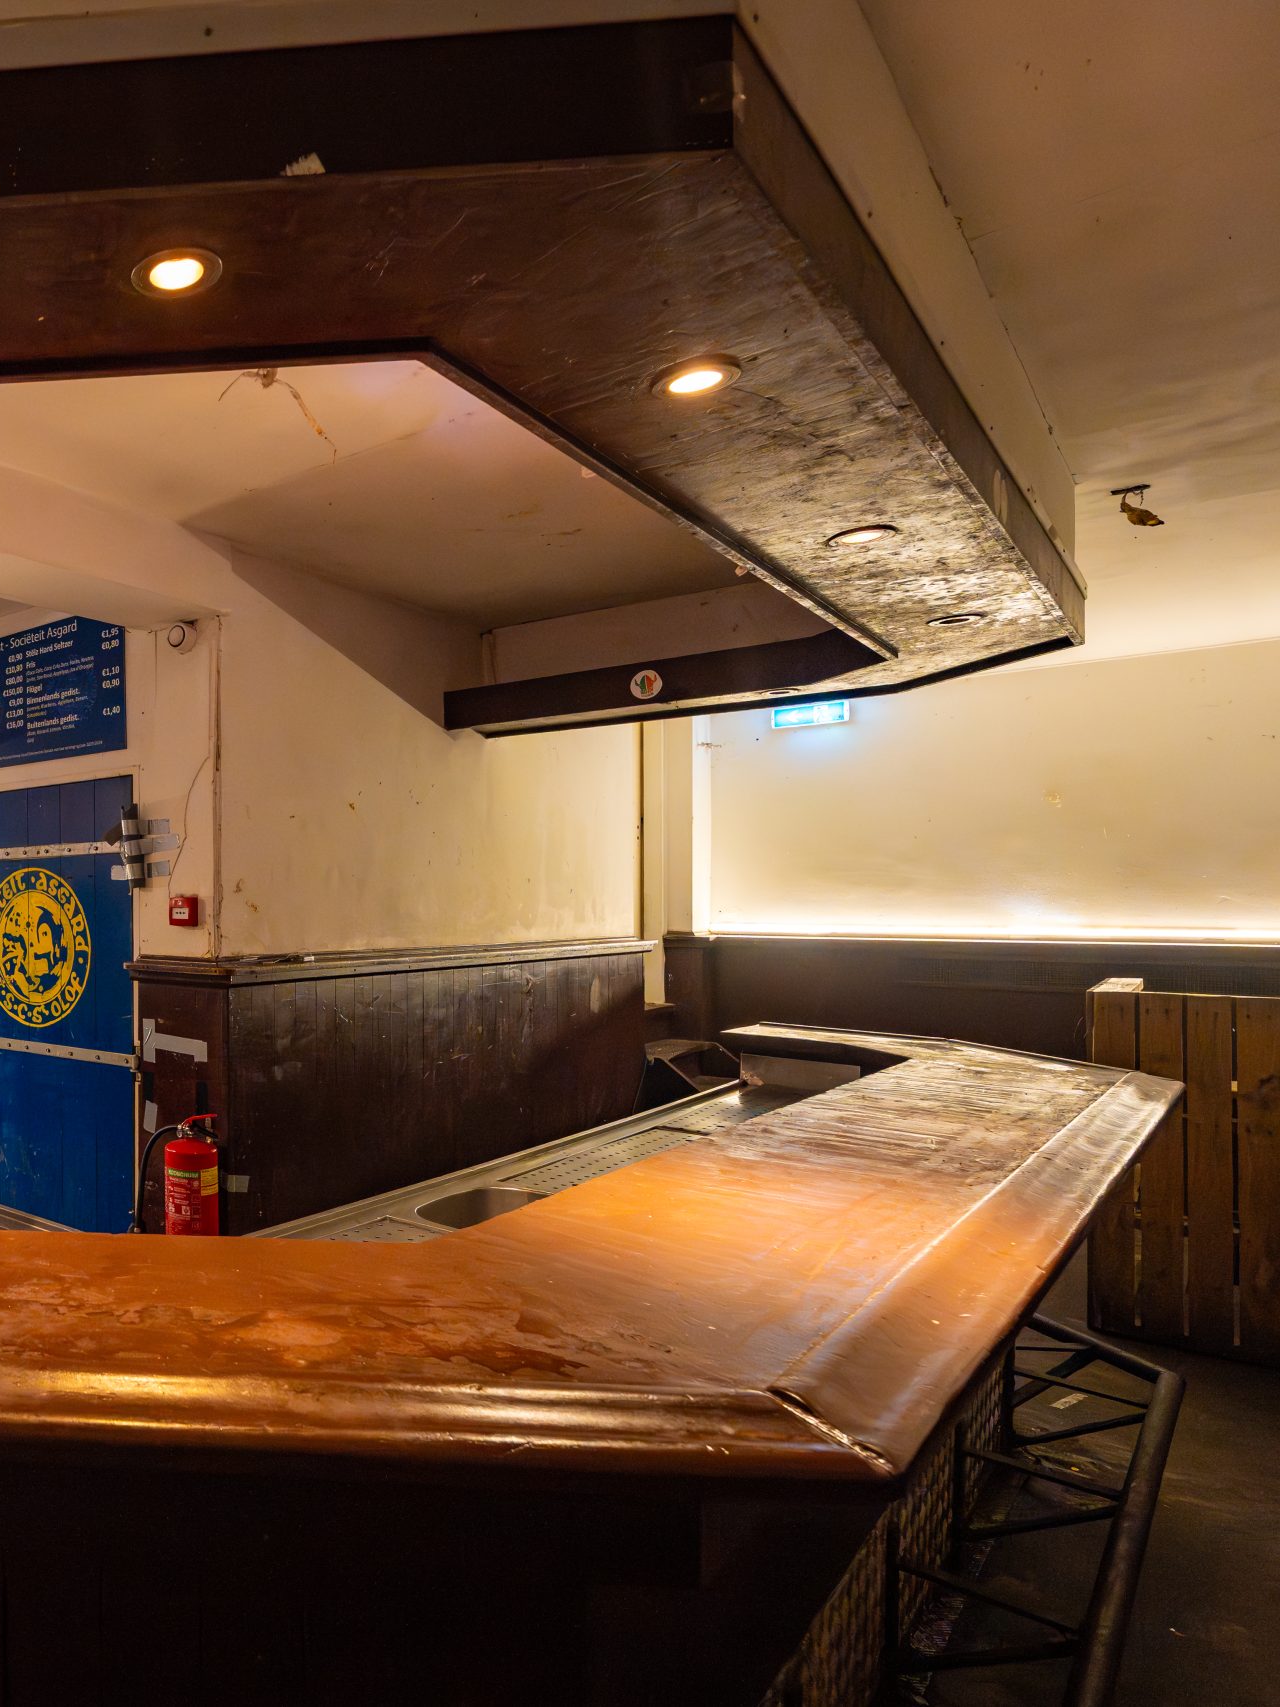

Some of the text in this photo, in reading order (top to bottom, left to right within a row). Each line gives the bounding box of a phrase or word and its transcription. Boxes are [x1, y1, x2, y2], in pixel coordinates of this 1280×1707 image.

[10, 630, 45, 649] Sociëteit
[46, 620, 77, 639] Asgard
[40, 643, 53, 654] Hard
[54, 640, 73, 650] Seltzer
[101, 627, 119, 638] €1,95
[25, 661, 36, 669] Fris
[102, 666, 120, 677] €1,10
[26, 692, 60, 705] Binnenlands
[26, 717, 60, 730] Buitenlands
